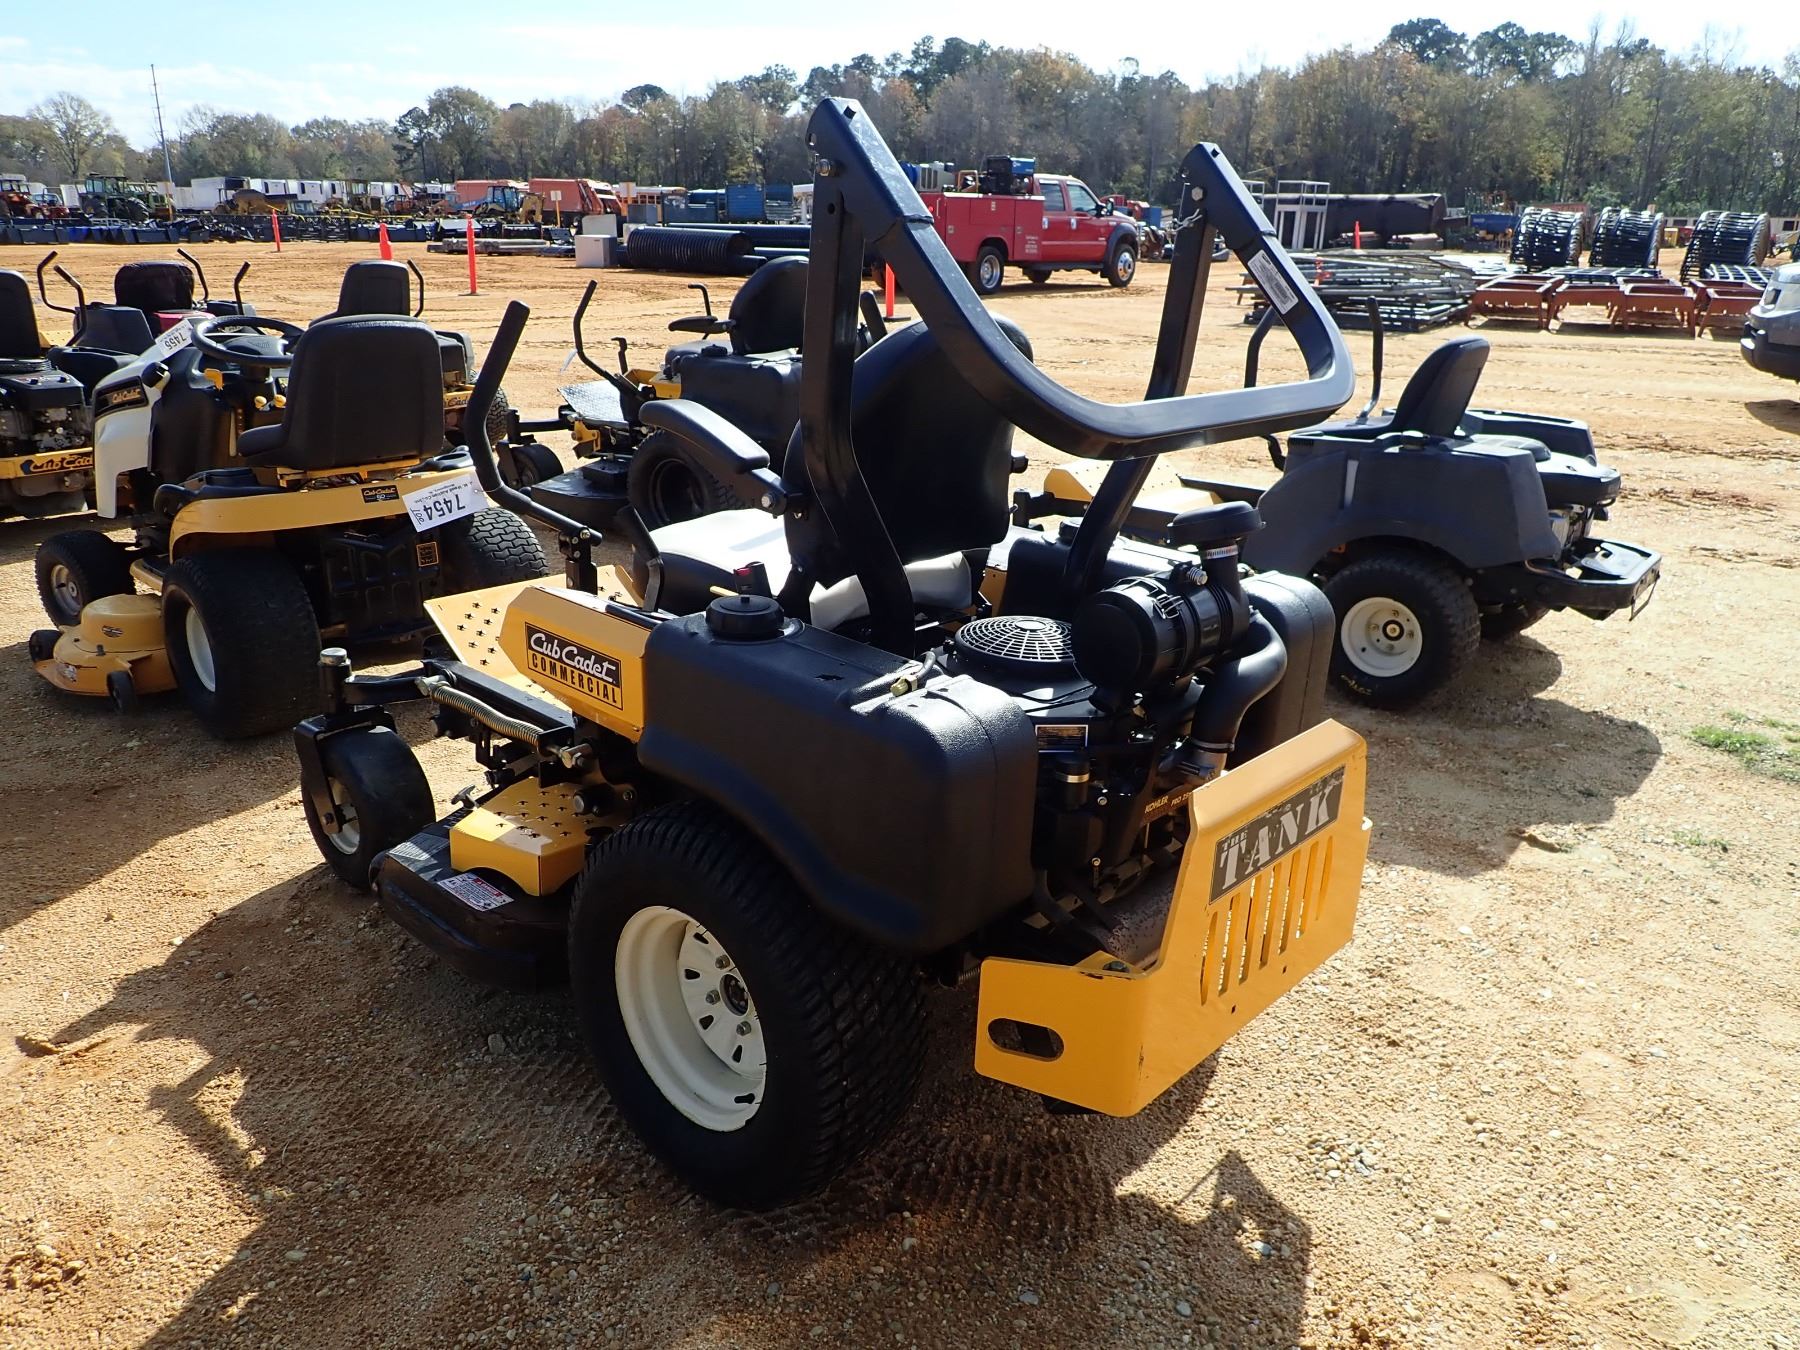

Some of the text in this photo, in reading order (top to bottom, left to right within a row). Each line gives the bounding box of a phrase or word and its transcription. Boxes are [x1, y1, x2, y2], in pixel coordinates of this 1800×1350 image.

[165, 332, 187, 350] 7455
[63, 454, 93, 468] Cad
[423, 494, 466, 521] 7454
[530, 632, 617, 683] Cub Cadet
[532, 653, 617, 703] COMMERCIAL
[1144, 795, 1169, 814] KOHLER
[1220, 782, 1337, 890] TANK
[1221, 830, 1249, 851] THE
